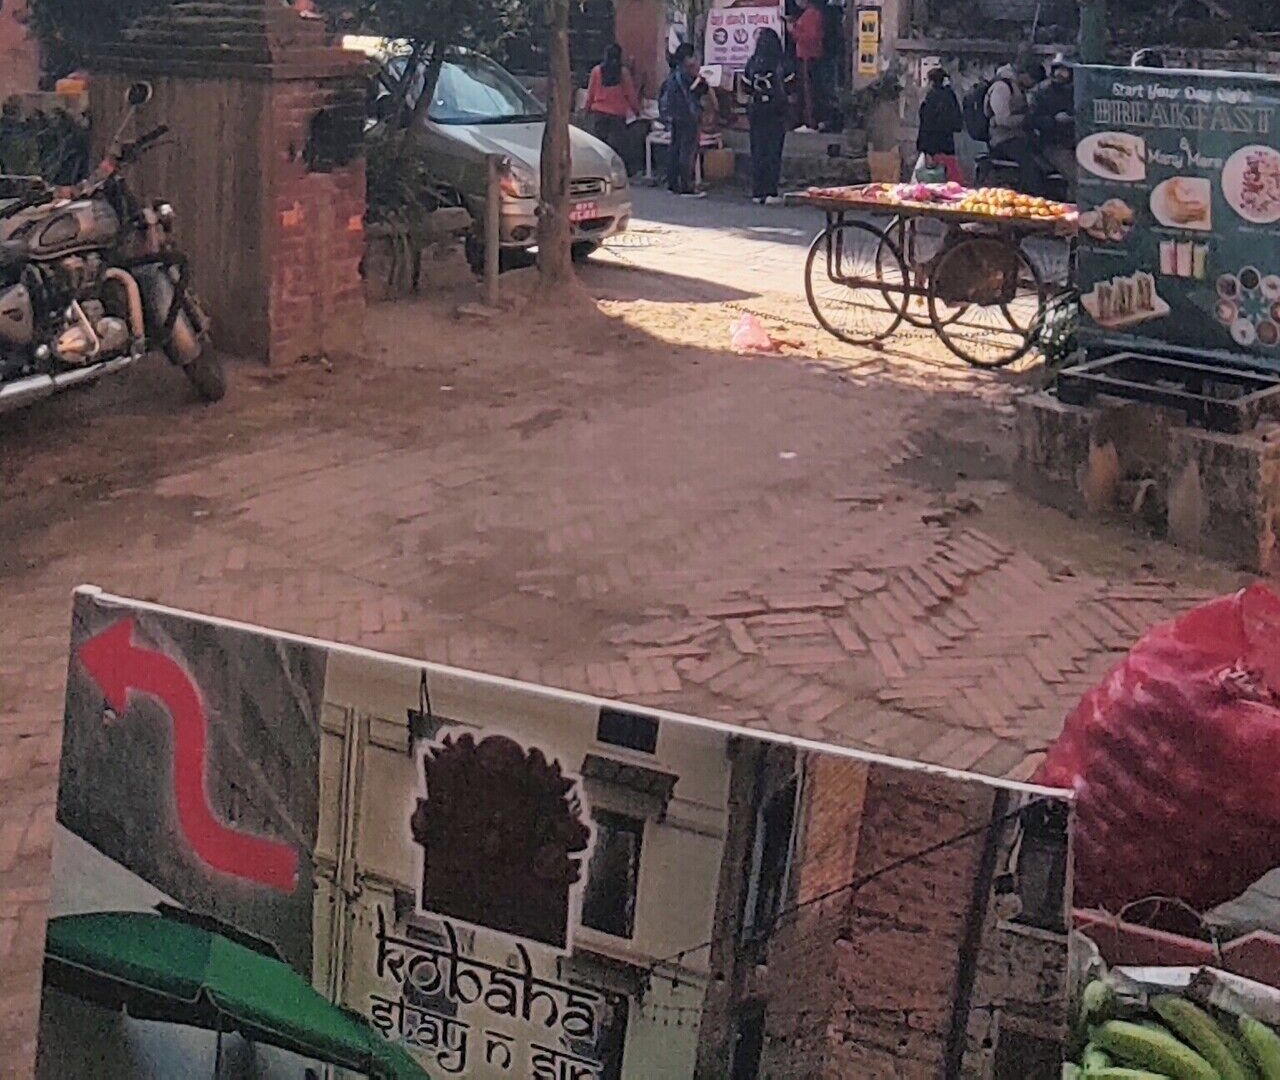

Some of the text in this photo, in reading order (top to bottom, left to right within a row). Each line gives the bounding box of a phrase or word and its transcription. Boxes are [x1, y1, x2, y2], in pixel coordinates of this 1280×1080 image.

[1092, 98, 1277, 134] BREAKFAST
[1112, 82, 1144, 99] Start
[1147, 83, 1180, 100] Your
[1183, 85, 1213, 104] Day
[376, 904, 599, 1038] kobaha
[370, 994, 470, 1072] stay
[486, 1030, 515, 1069] n
